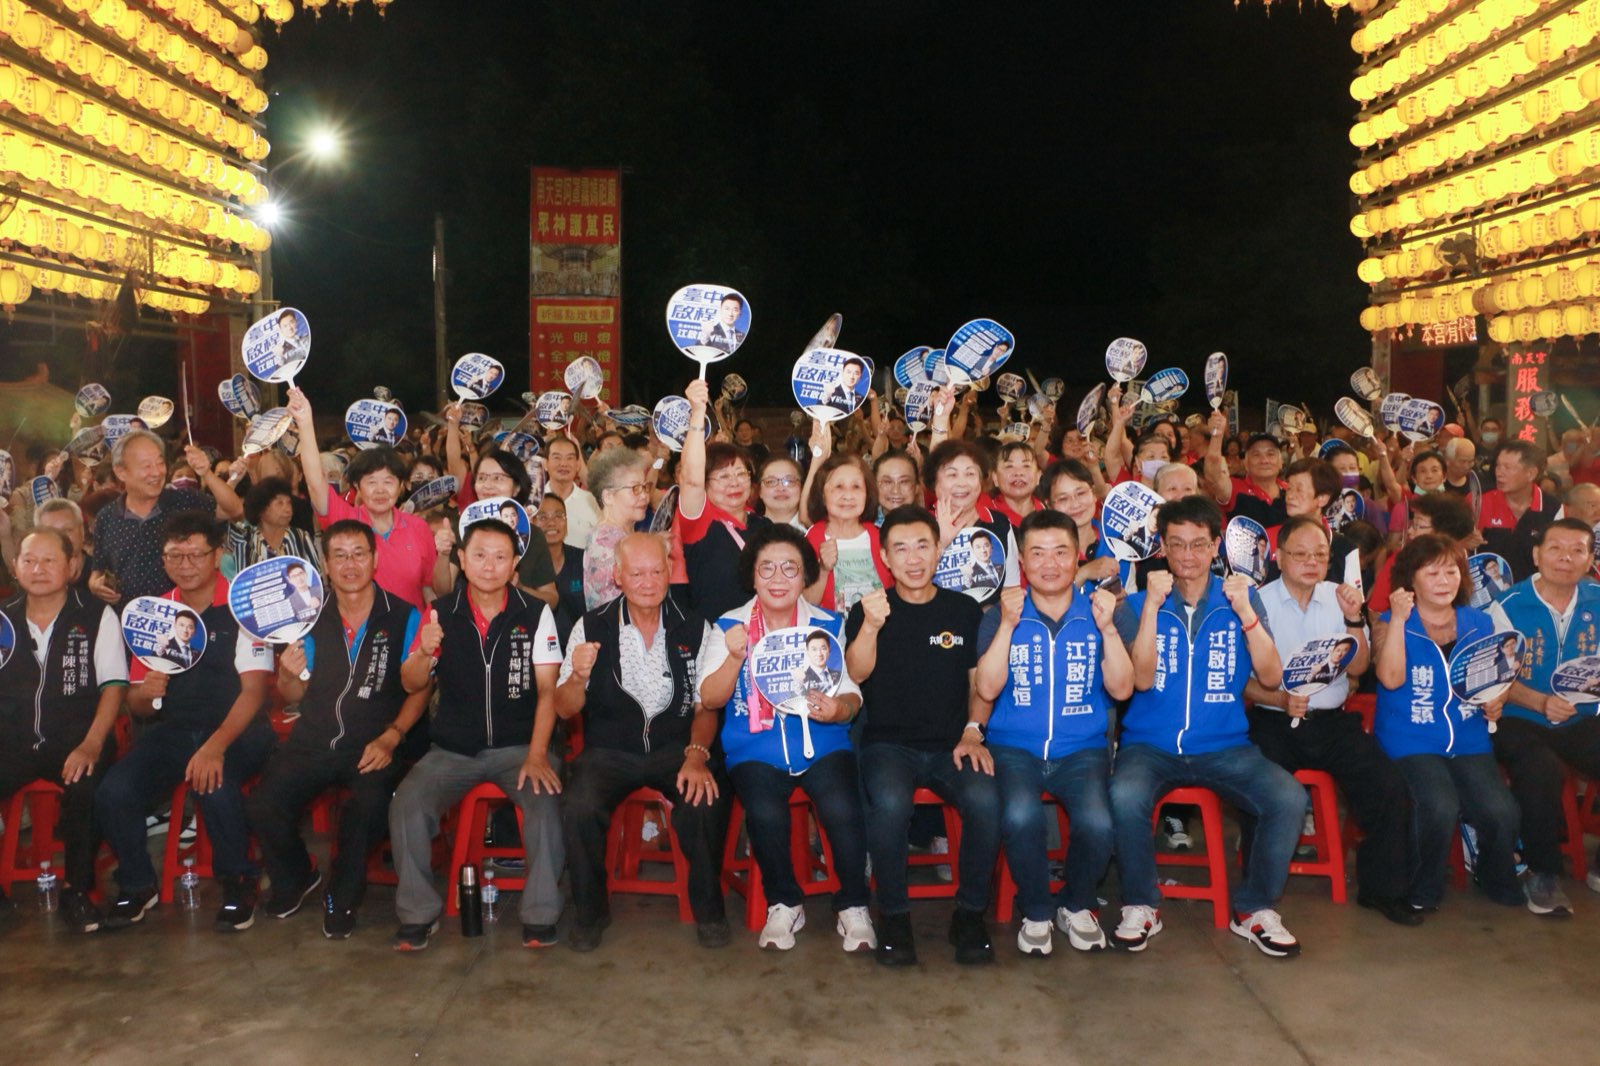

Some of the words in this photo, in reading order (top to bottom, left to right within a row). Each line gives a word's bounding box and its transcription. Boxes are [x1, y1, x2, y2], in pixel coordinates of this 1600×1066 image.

[683, 288, 723, 303] 臺中
[250, 318, 280, 339] 臺中
[551, 331, 611, 345] 光明燈
[808, 351, 846, 366] 臺中
[1511, 352, 1547, 365] 南天宮
[1125, 482, 1156, 506] 臺中
[467, 503, 500, 520] 臺中
[136, 599, 178, 617] 臺中
[763, 632, 807, 651] 臺中
[755, 653, 805, 673] 啟程
[1033, 644, 1043, 685] 立法委員
[1208, 631, 1227, 690] 江啟臣
[1066, 641, 1086, 703] 江啟臣
